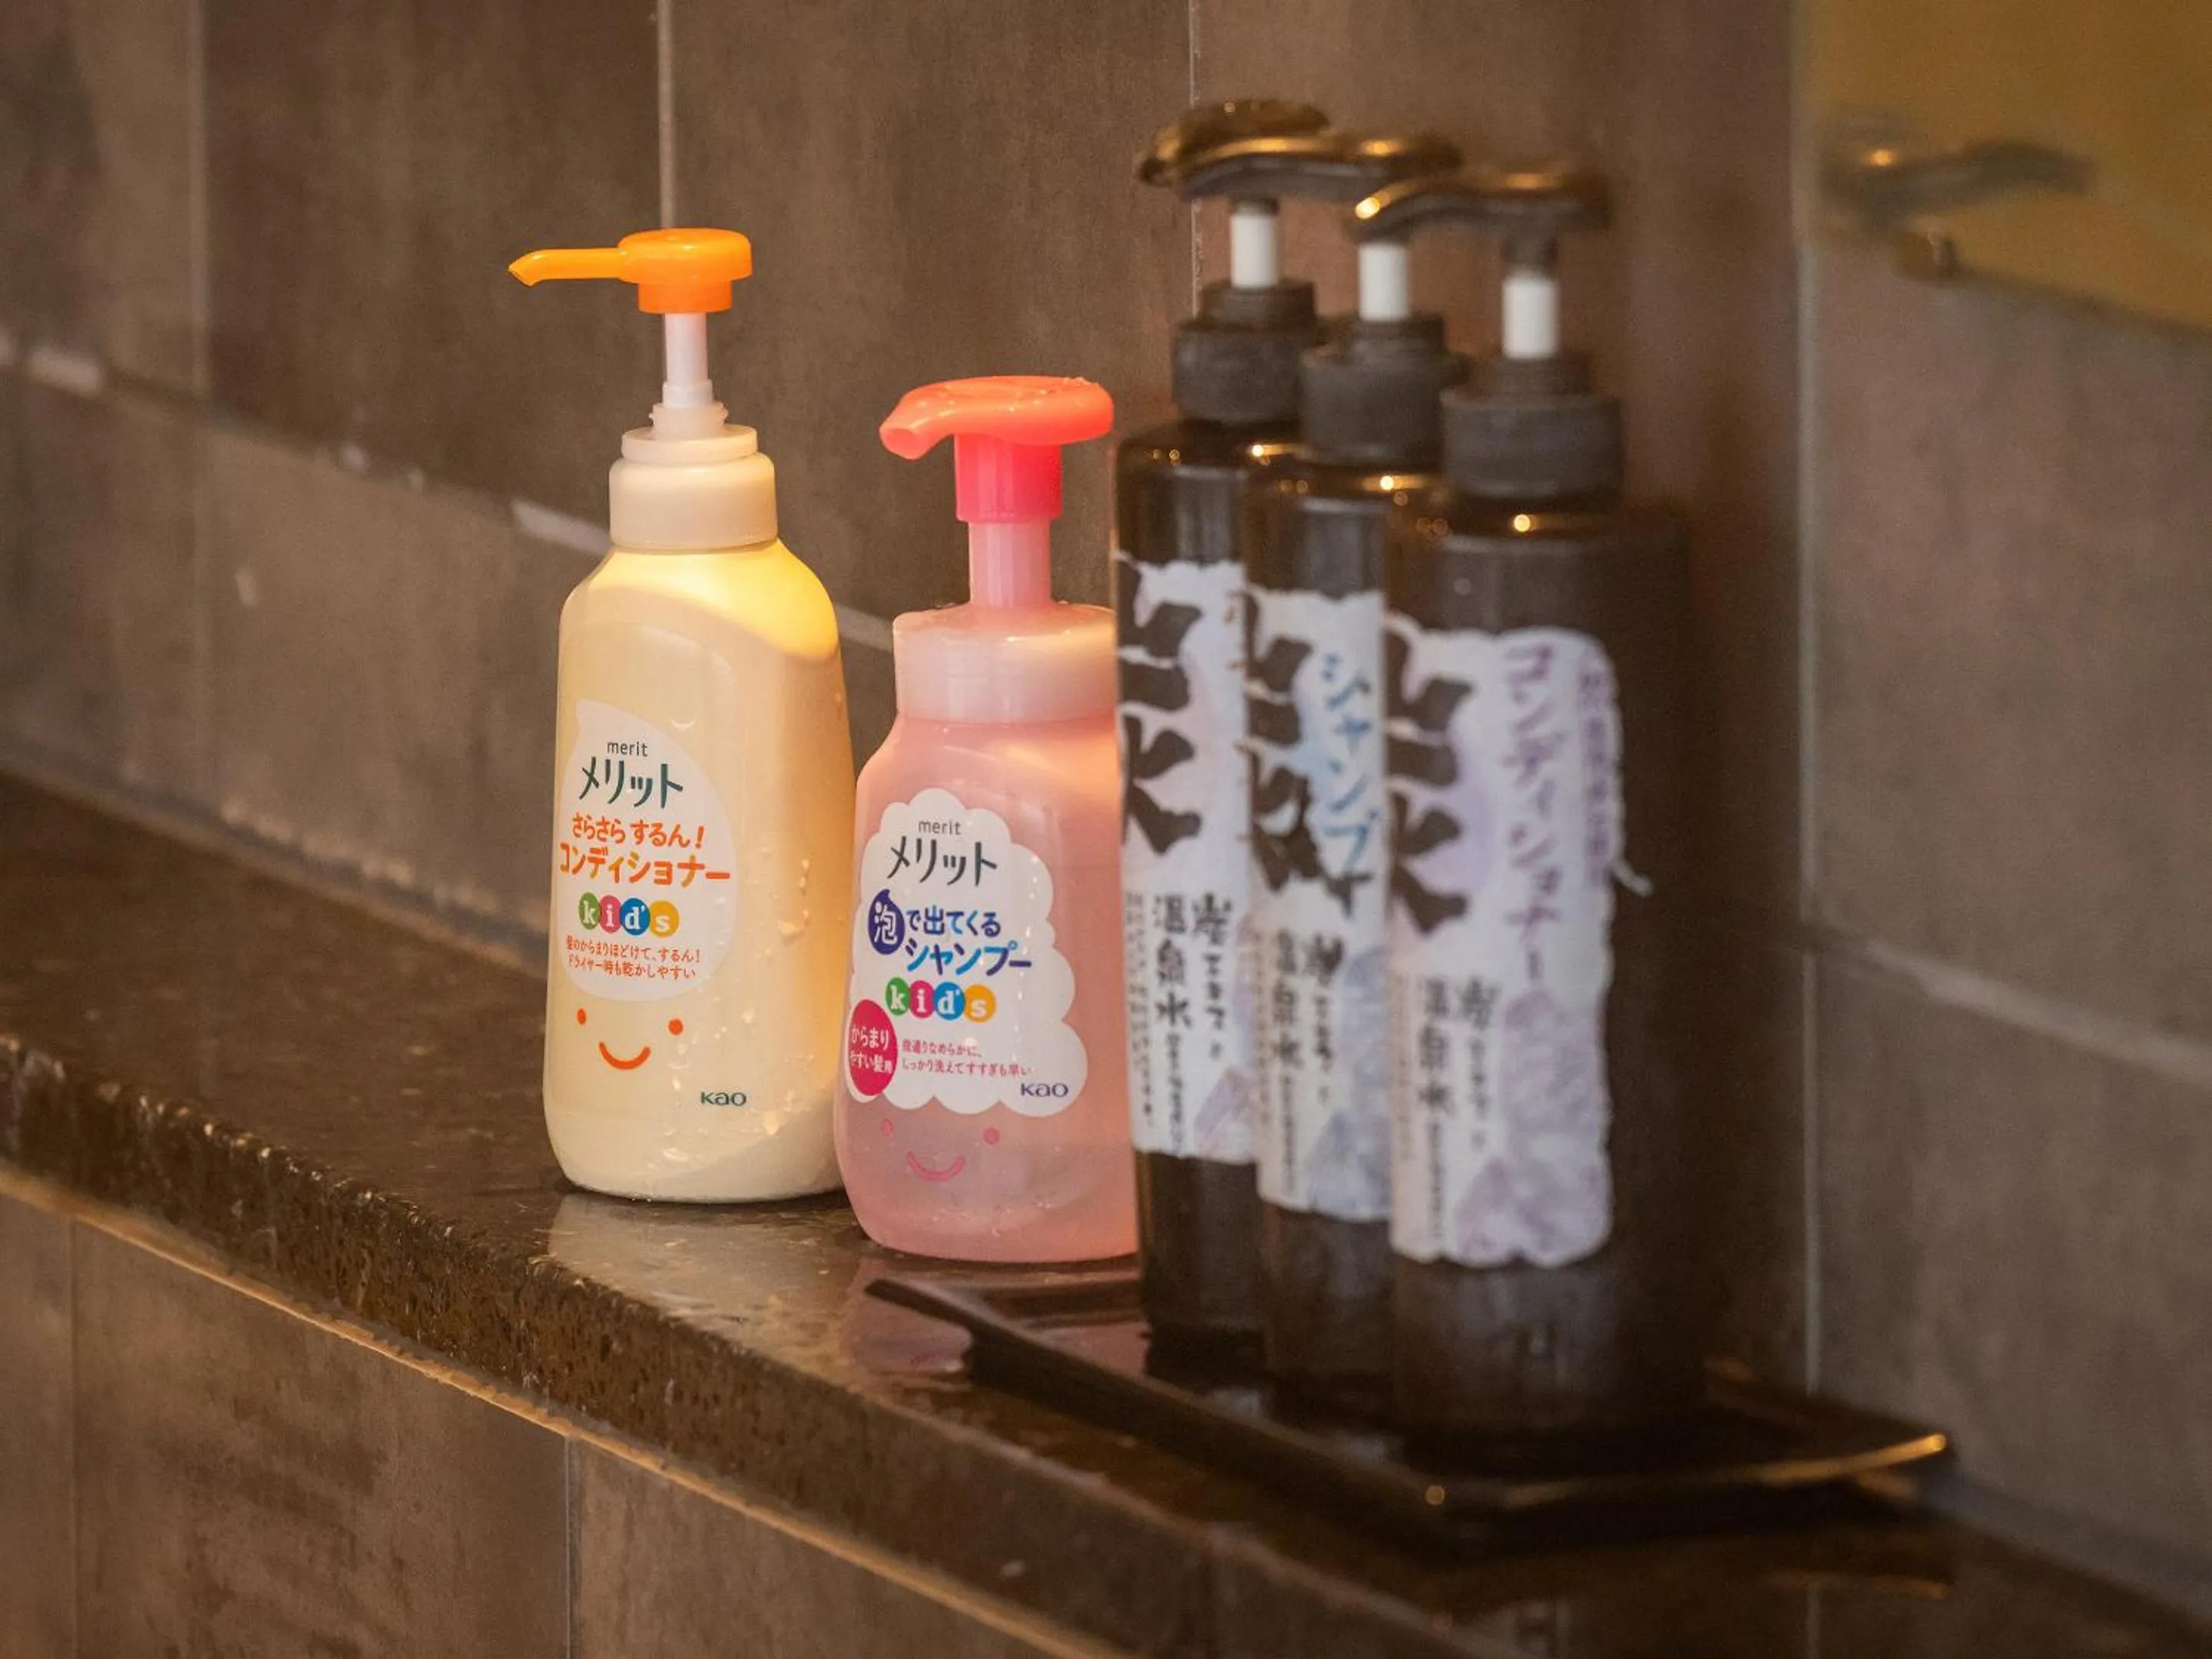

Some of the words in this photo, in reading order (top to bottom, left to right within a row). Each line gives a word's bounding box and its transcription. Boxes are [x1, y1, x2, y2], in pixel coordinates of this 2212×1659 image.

[606, 741, 648, 757] merit
[578, 757, 684, 809] メリット
[918, 820, 962, 835] merit
[560, 843, 731, 888] コンディショナー
[886, 836, 998, 886] メリット
[873, 901, 1002, 945] 泡で出てくる
[905, 938, 1032, 976] シャンプー
[851, 1024, 889, 1051] からまり
